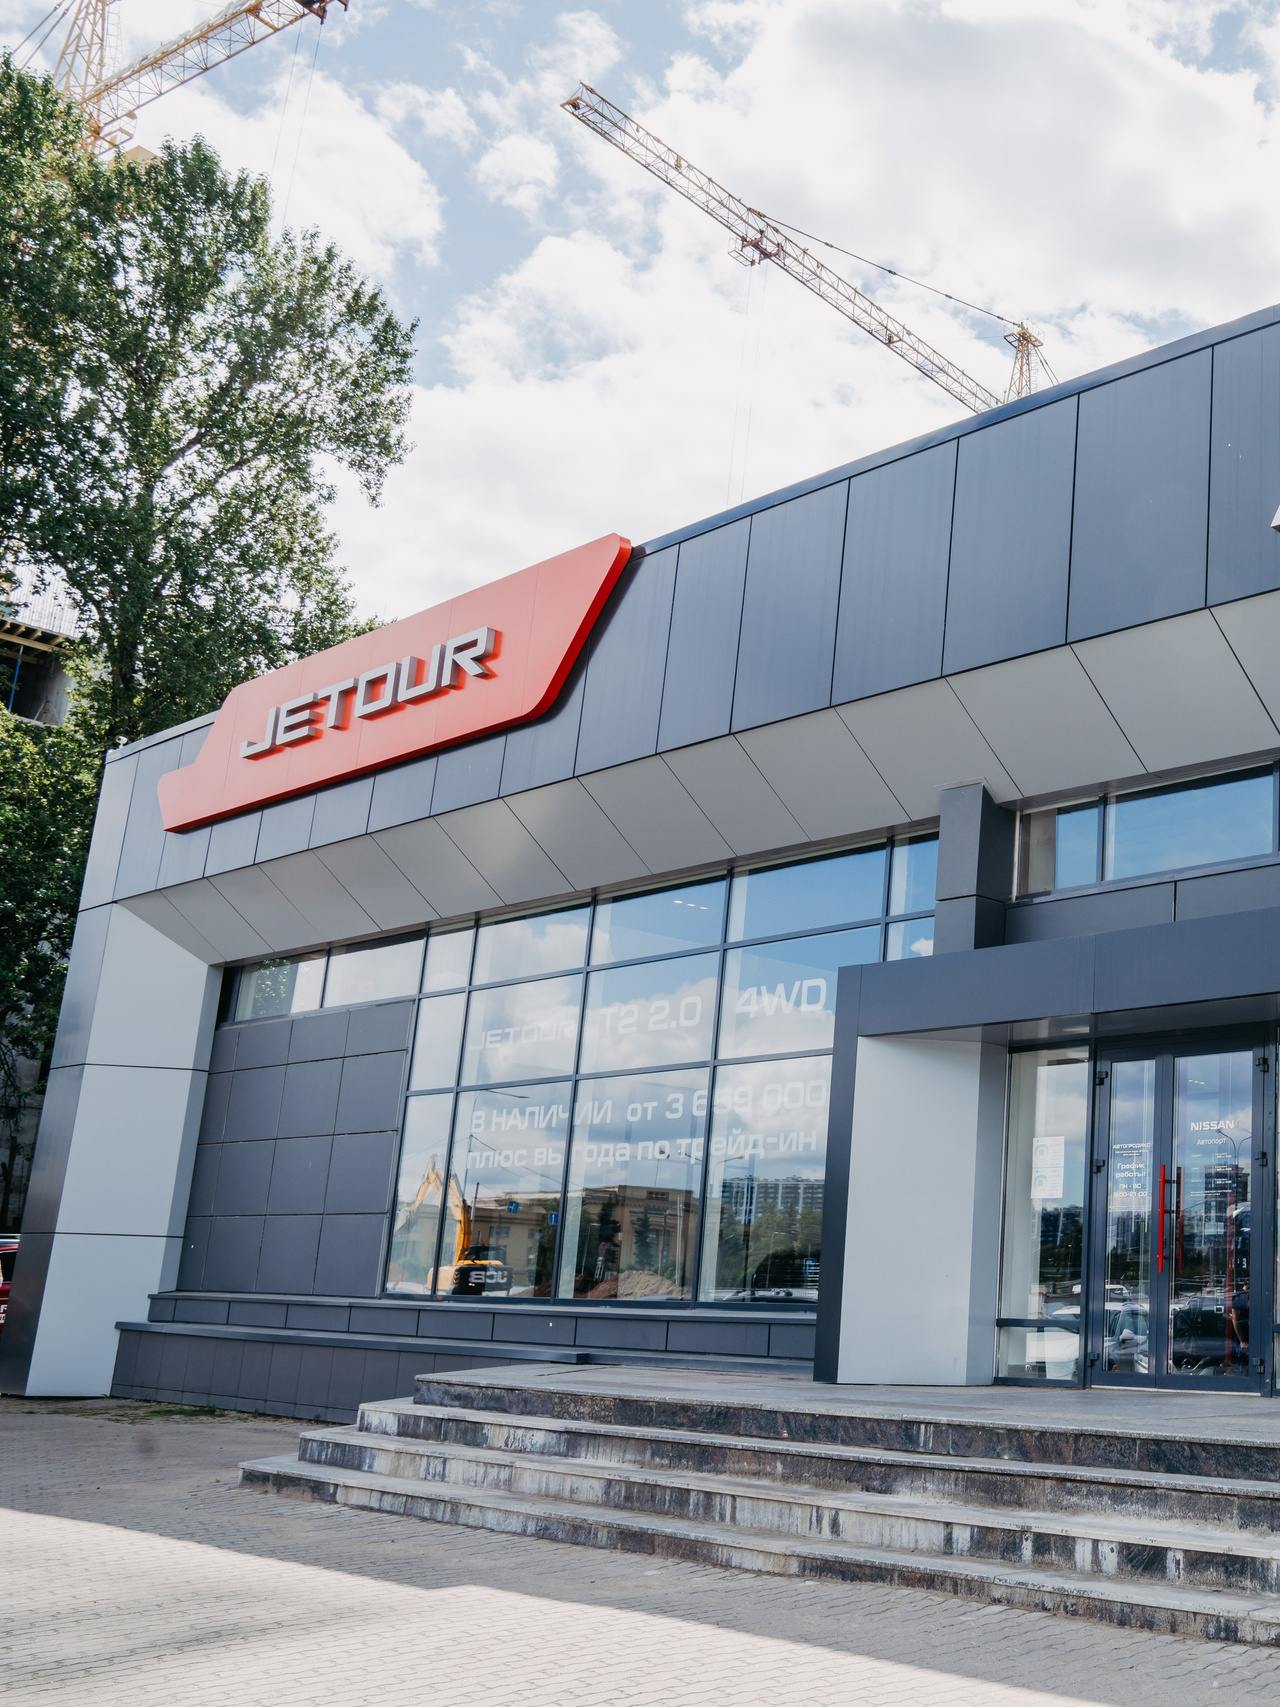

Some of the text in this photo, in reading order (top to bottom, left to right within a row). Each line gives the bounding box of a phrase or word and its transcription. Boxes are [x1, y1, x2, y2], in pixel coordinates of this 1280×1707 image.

[240, 626, 496, 760] JETOUR
[467, 978, 827, 1051] JETOUR T2 2.0 4WD
[471, 1110, 485, 1133] В
[491, 1099, 613, 1133] НАЛИЧИИ
[626, 1101, 658, 1122] от
[665, 1092, 684, 1119] 3
[762, 1080, 827, 1112] 000
[1190, 1120, 1235, 1131] NISSAN
[467, 1149, 528, 1169] плюс
[637, 1140, 670, 1161] по
[676, 1127, 817, 1165] трейд-ин
[1117, 1163, 1145, 1171] График
